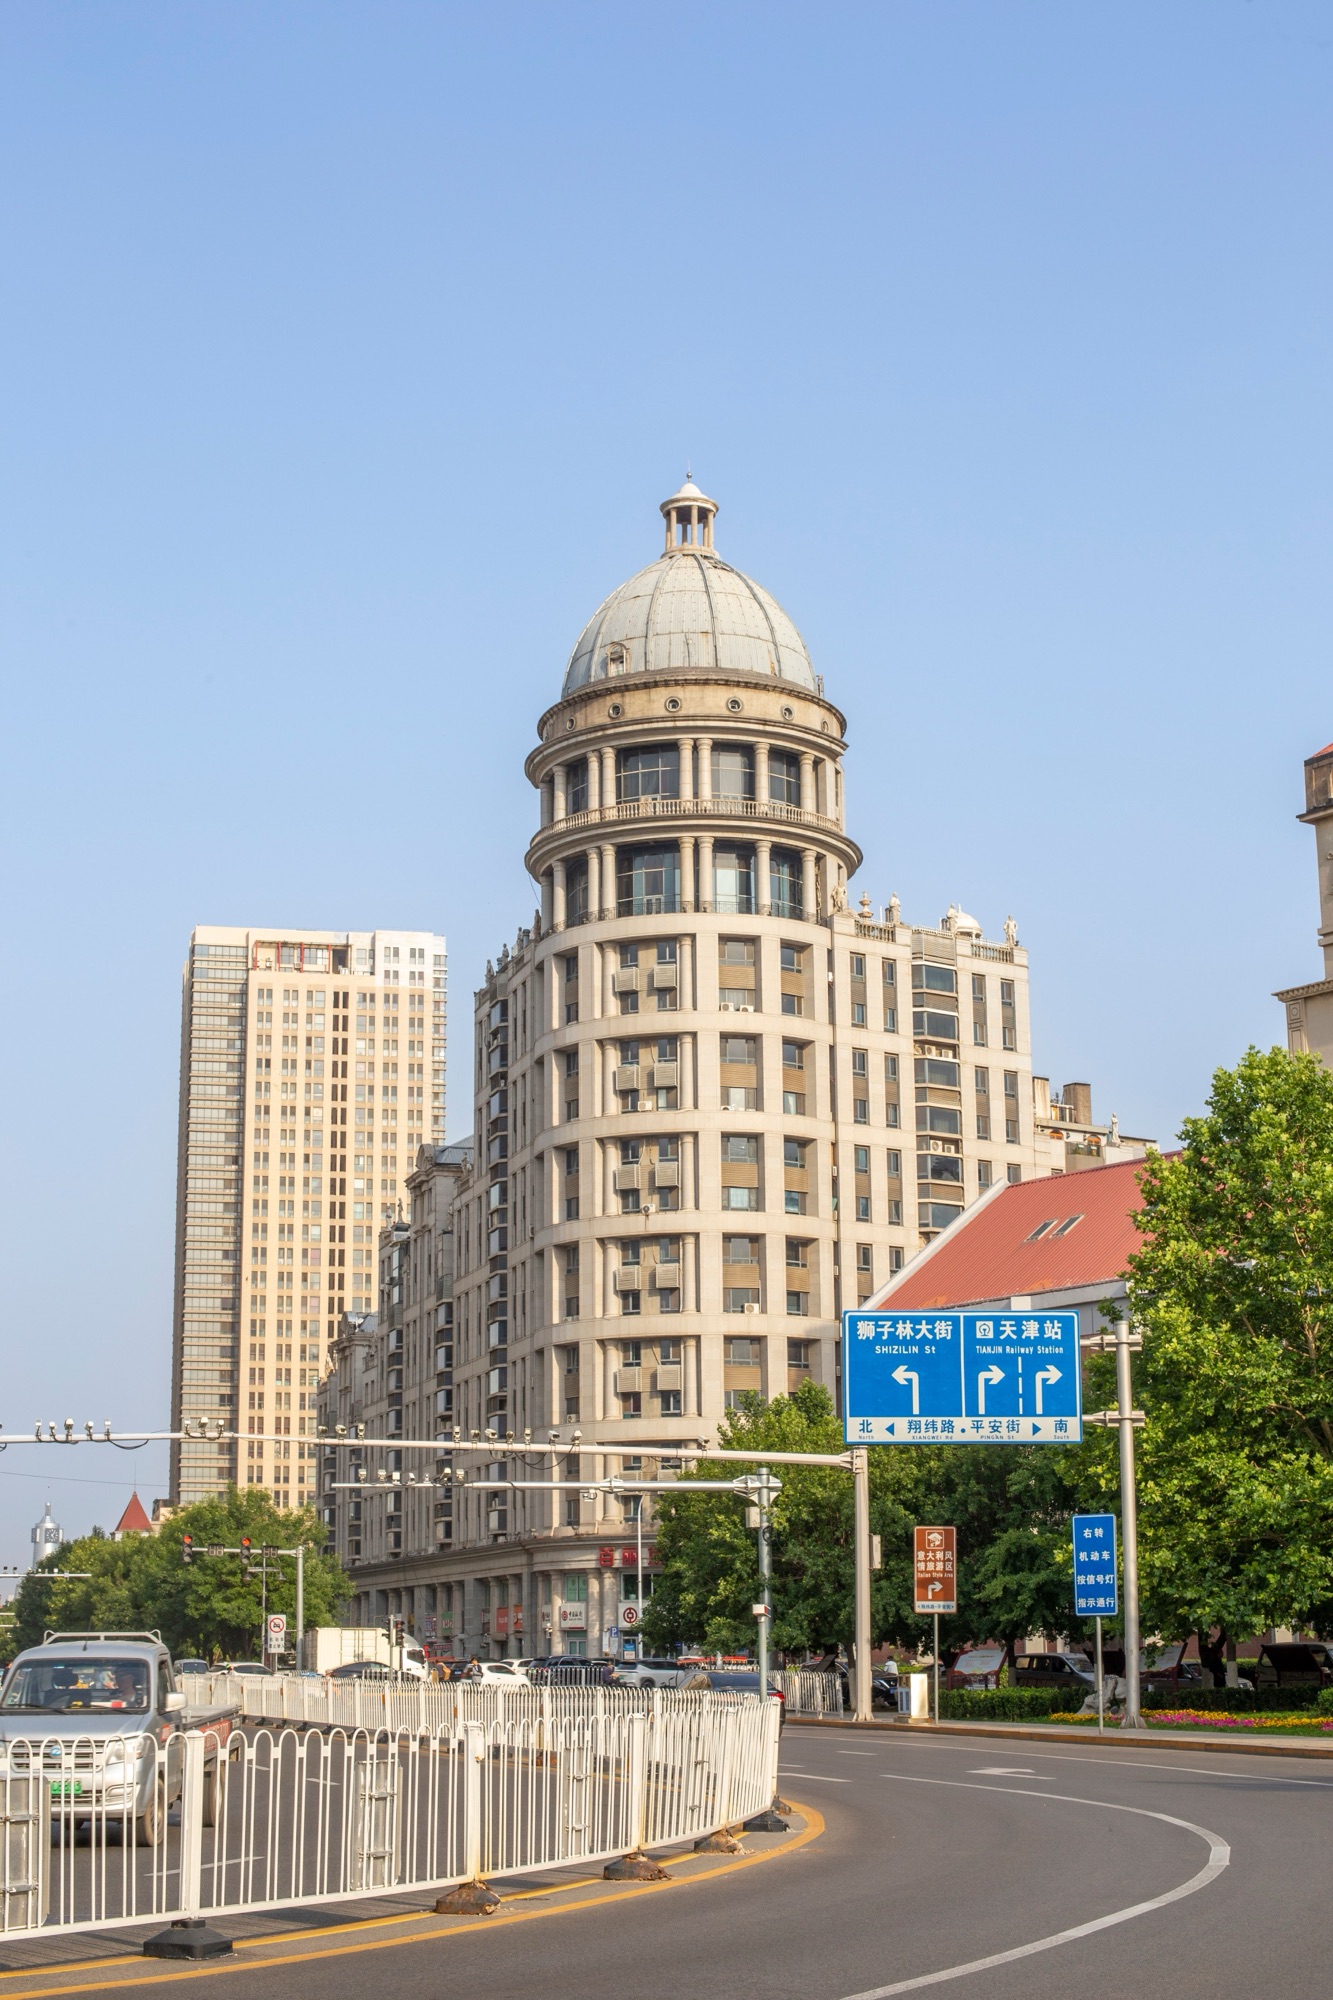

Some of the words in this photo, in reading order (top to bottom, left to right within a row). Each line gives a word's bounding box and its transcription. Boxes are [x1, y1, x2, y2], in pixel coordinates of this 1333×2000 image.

[857, 1320, 953, 1340] 狮子林大街
[999, 1320, 1062, 1340] 天津站
[875, 1345, 919, 1354] SHIZILIN
[924, 1345, 936, 1354] St
[976, 1346, 1003, 1354] TIANJIN
[1006, 1345, 1034, 1355] Railway
[1037, 1345, 1064, 1354] Station
[859, 1419, 873, 1433] 北
[907, 1419, 955, 1434] 翔纬路
[970, 1419, 1021, 1433] 平安街
[1053, 1419, 1068, 1433] 南
[1083, 1528, 1104, 1538] 右转
[917, 1551, 953, 1560] 意大利风
[1079, 1551, 1111, 1561] 机动车
[917, 1562, 953, 1571] 情旅游区
[1077, 1575, 1115, 1585] 按信号灯
[1078, 1598, 1115, 1608] 指示通行
